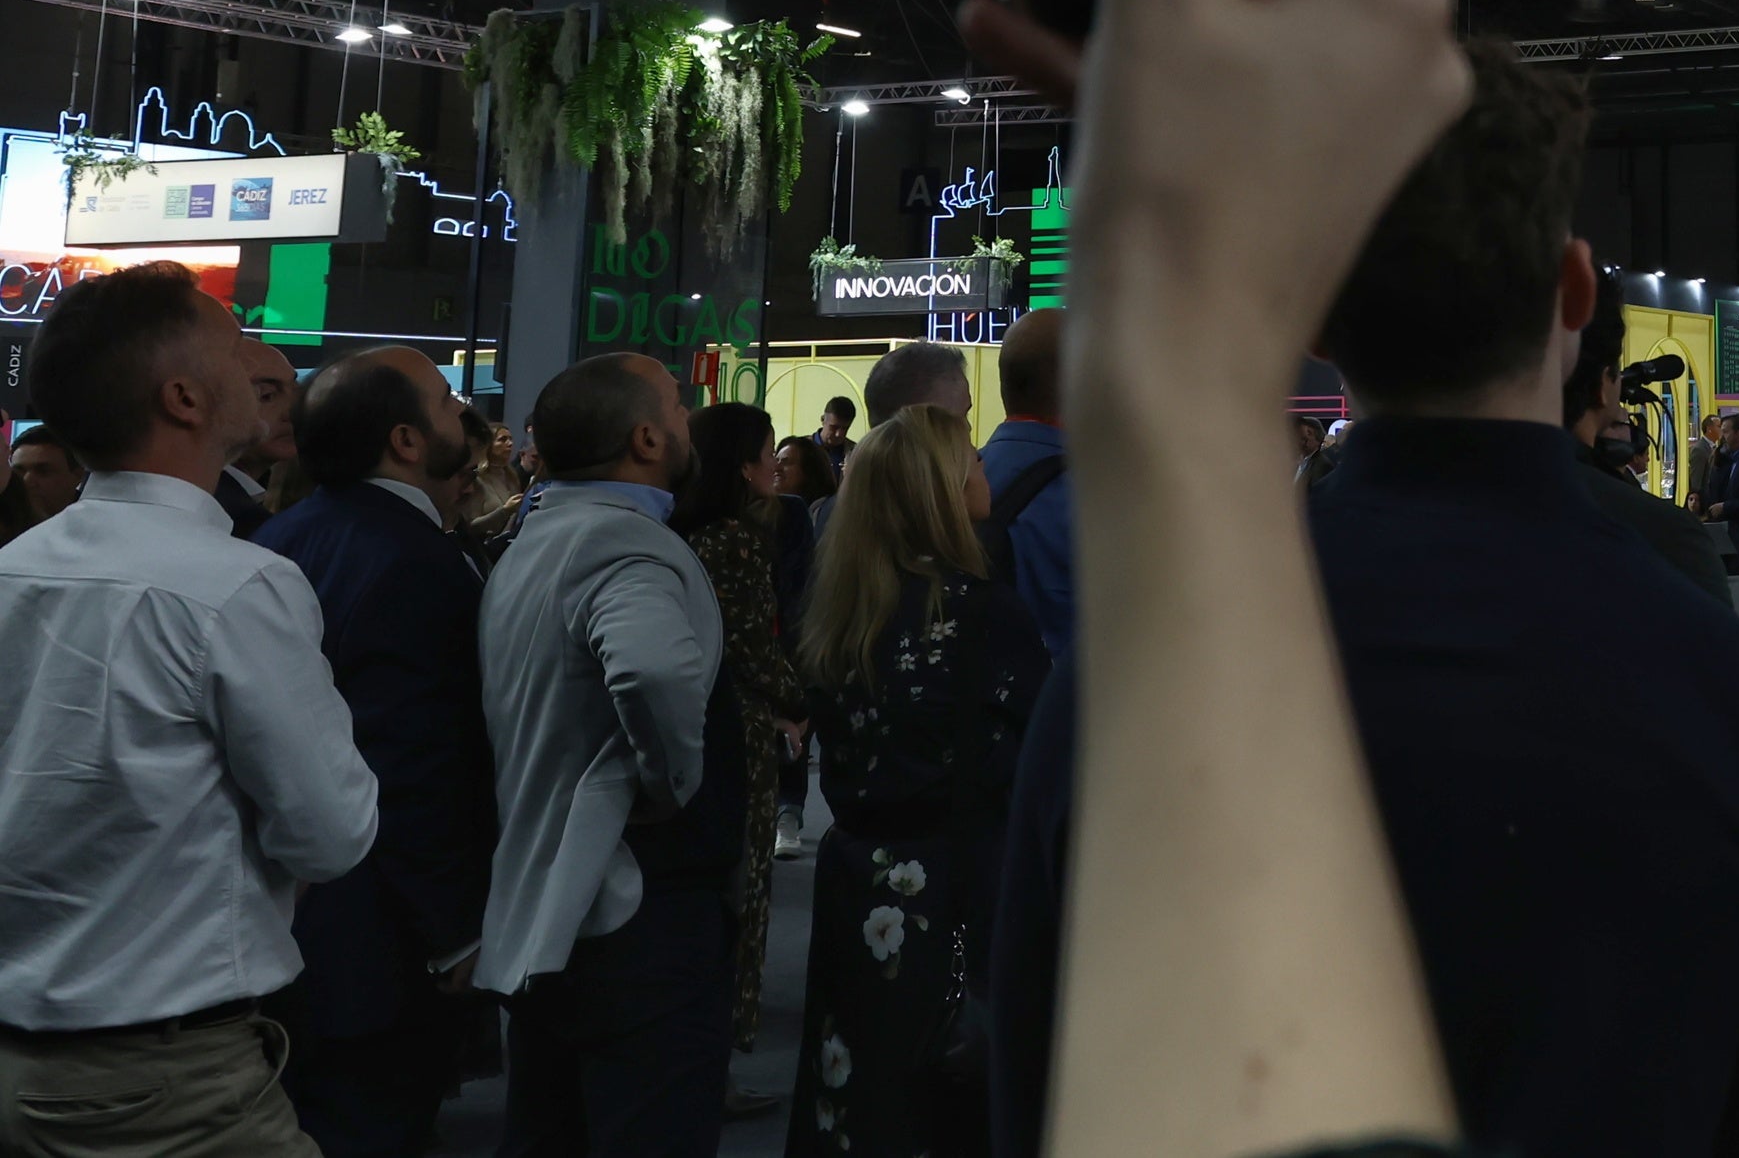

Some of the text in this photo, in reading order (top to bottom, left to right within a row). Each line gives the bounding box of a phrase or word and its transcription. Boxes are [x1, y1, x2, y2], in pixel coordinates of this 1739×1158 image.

[288, 188, 328, 205] JEREZ
[905, 175, 933, 207] A
[835, 268, 971, 299] INNOVACIÓN
[7, 344, 22, 388] CÁDIZ
